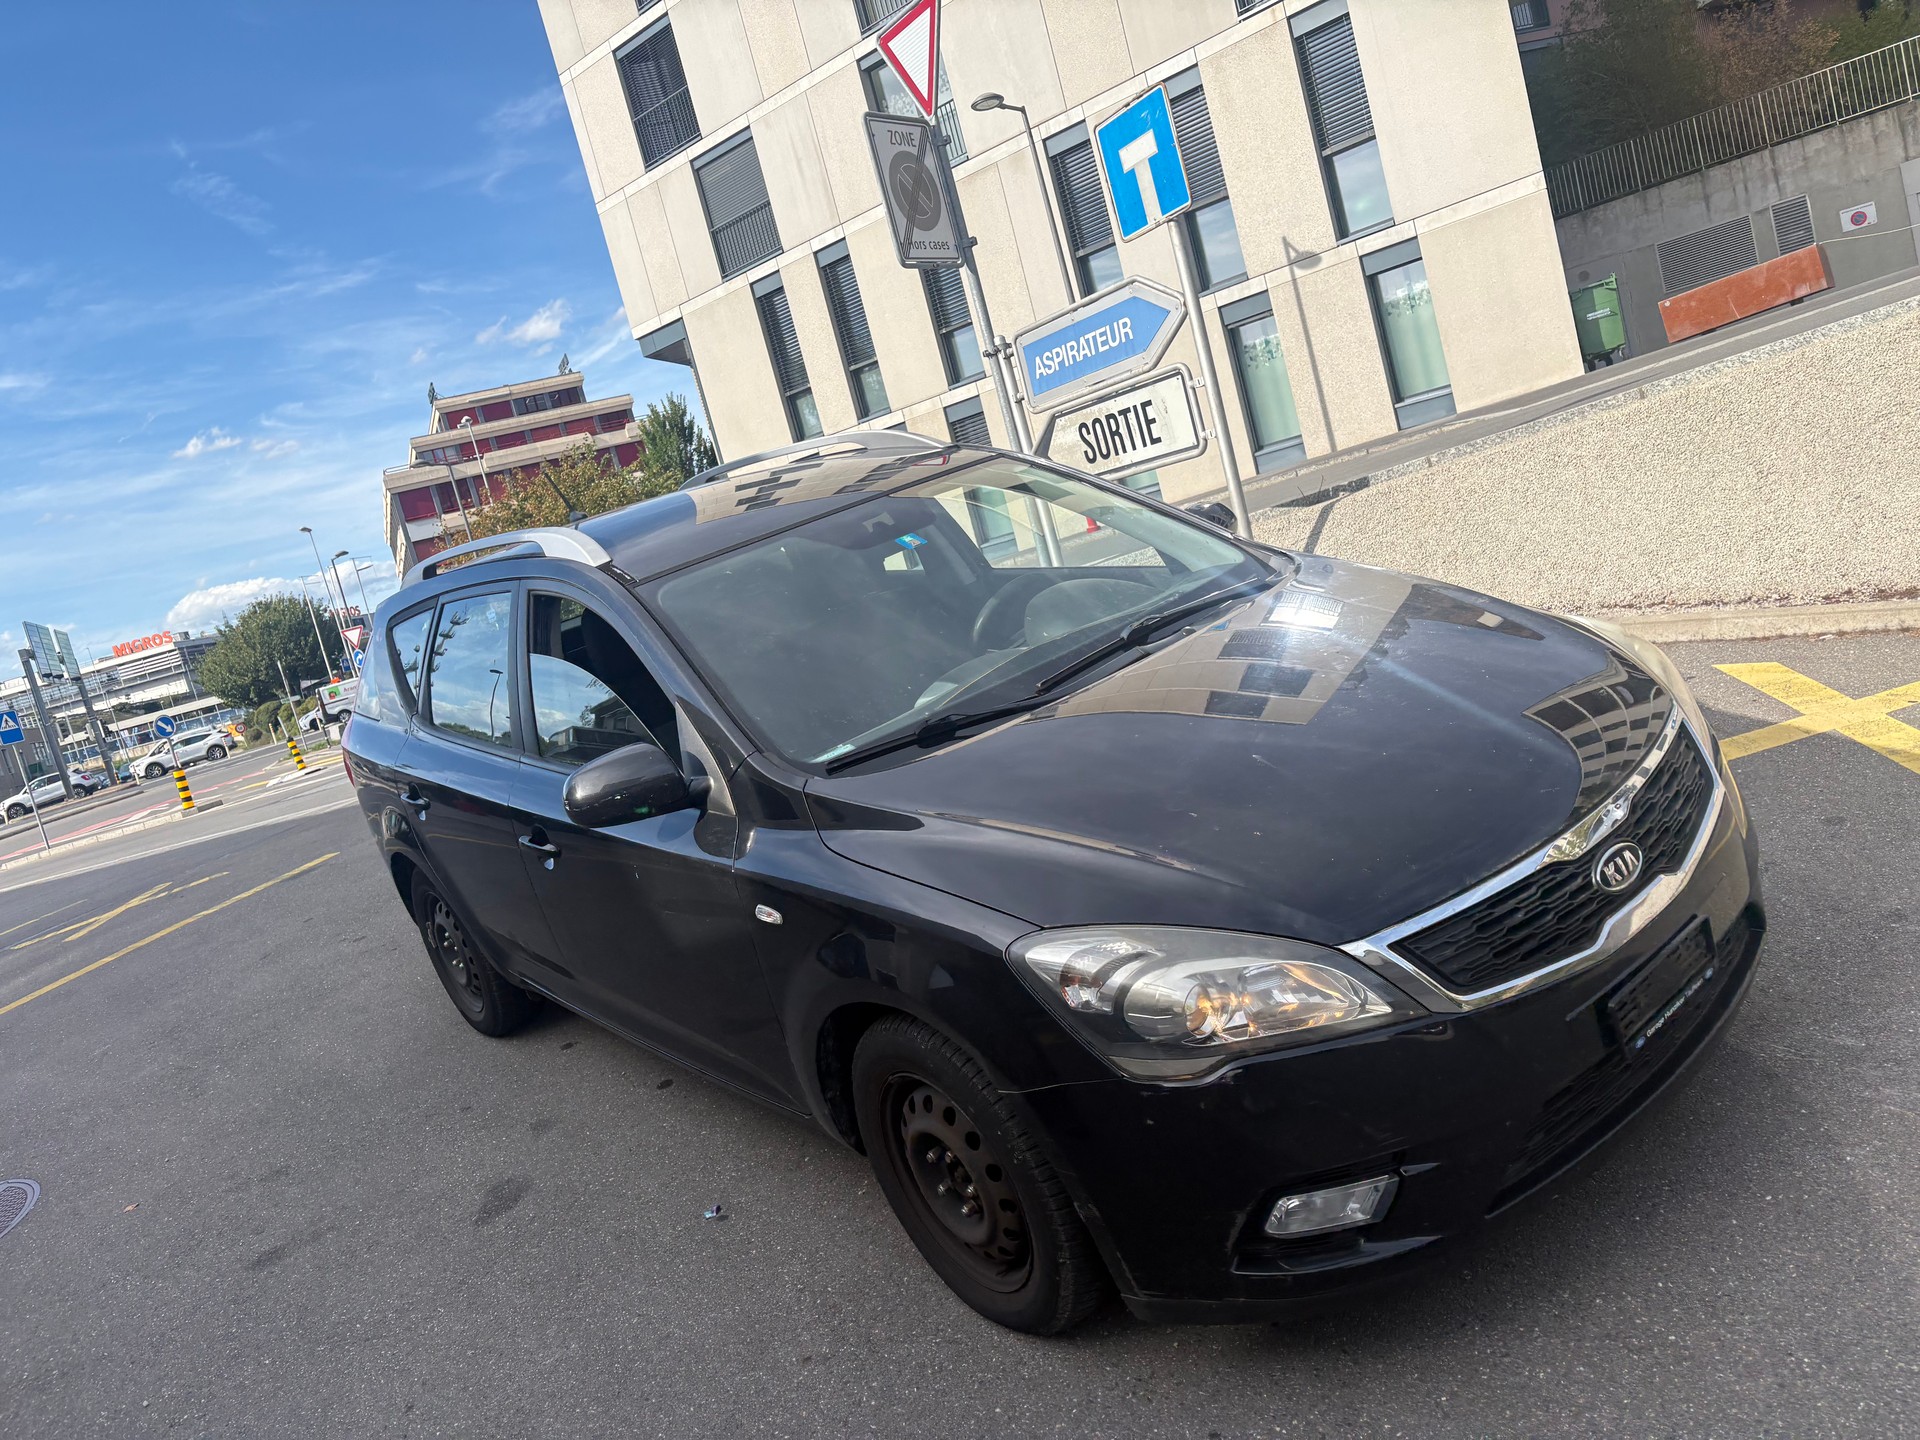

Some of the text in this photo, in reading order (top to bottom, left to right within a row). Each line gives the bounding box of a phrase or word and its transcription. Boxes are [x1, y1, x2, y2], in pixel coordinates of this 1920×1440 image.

[887, 129, 917, 148] ZONE
[928, 240, 951, 251] cases
[1035, 317, 1134, 380] ASPIRATEUR
[1078, 399, 1163, 465] SORTIE
[112, 630, 174, 657] MIGROS
[1602, 849, 1640, 887] KIA
[1646, 1017, 1665, 1038] Garage
